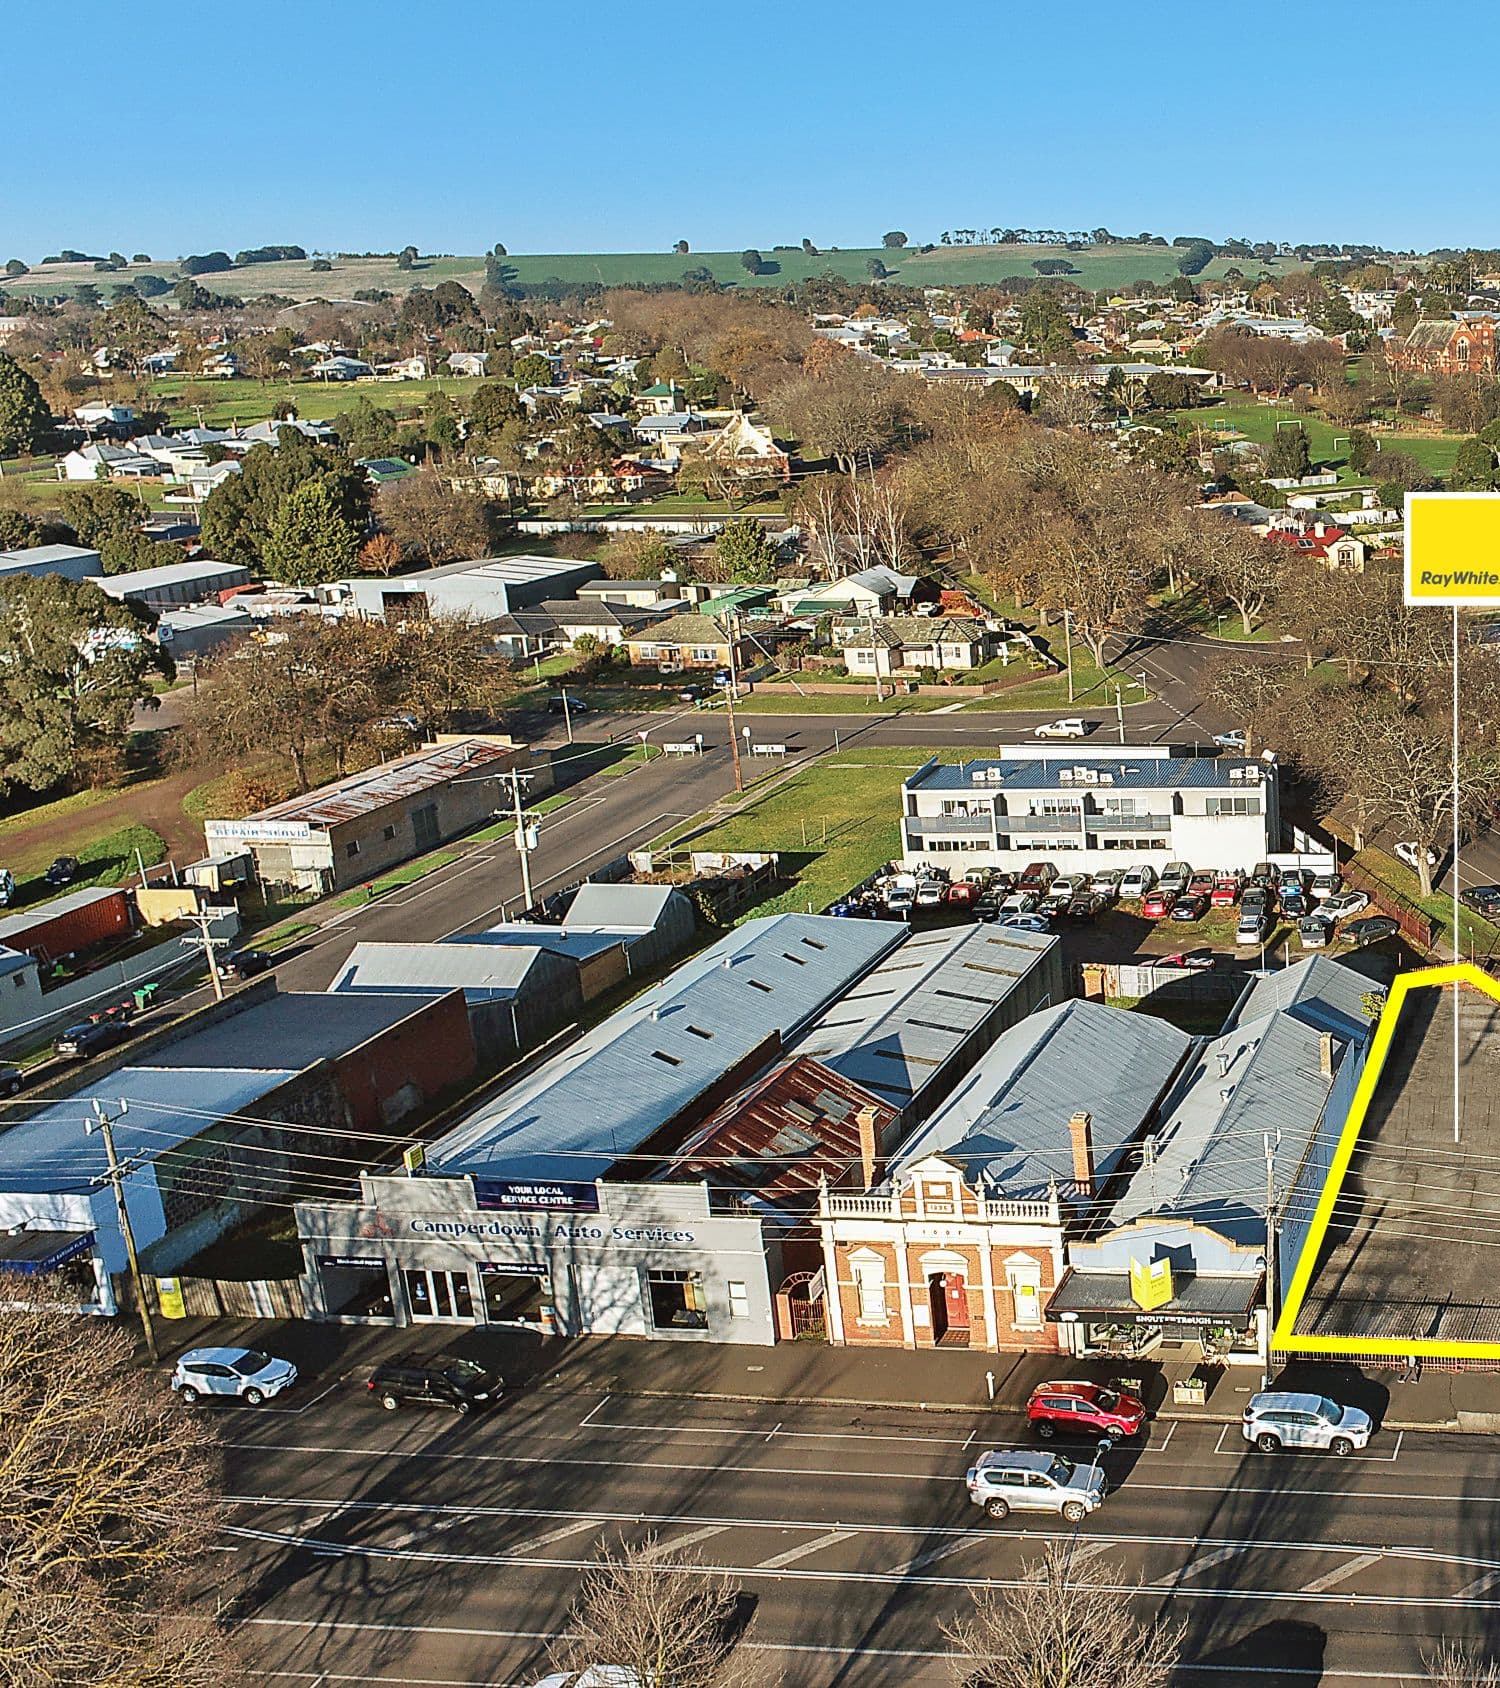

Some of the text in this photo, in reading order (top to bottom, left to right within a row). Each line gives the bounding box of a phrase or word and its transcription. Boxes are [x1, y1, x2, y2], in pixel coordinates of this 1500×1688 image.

[508, 1185, 564, 1195] YOUR LOCAL
[500, 1194, 575, 1205] SERVICE CENTRE
[410, 1219, 696, 1242] Camperdown Auto Services
[1135, 1315, 1165, 1323] SNOUT
[1175, 1316, 1212, 1325] TROUGH
